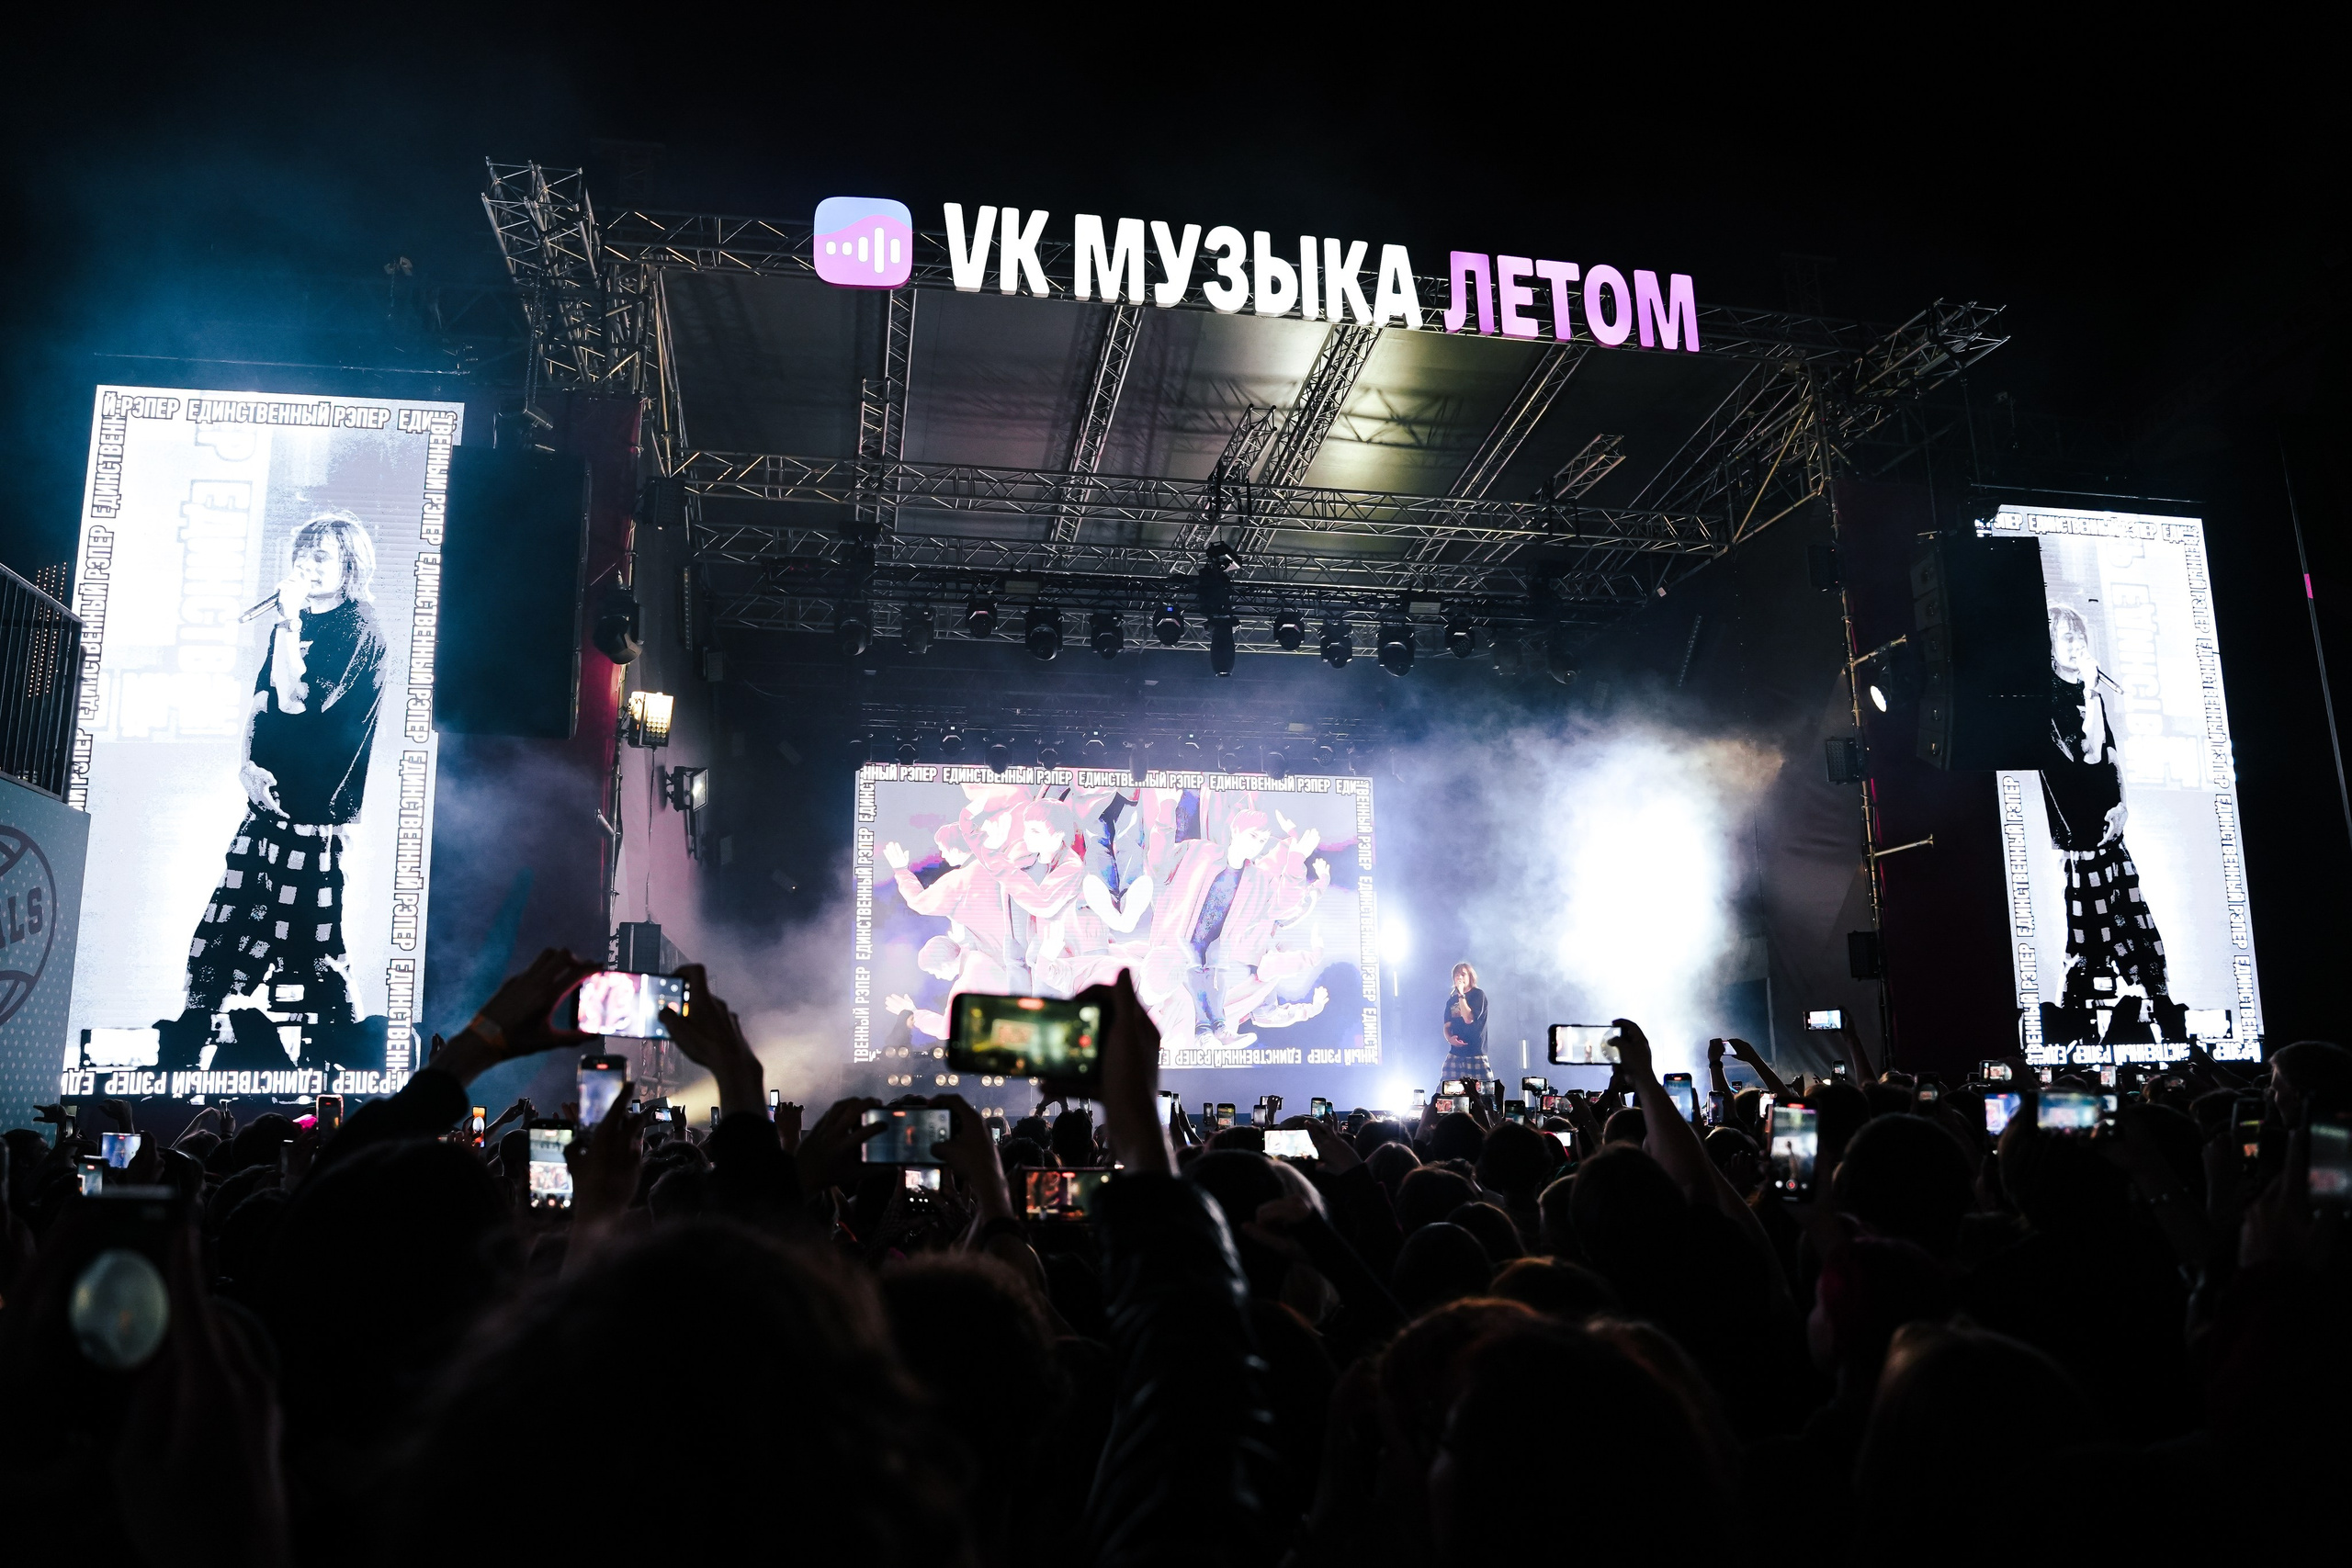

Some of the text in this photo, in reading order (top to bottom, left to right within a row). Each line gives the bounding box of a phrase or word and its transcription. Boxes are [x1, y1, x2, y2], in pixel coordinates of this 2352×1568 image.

[944, 203, 1701, 354] VK МУЗЫКА ЛЕТОМ
[119, 396, 180, 420] РЭПЕР
[187, 399, 332, 427] ЕДИНСТВЕННЫЙ
[333, 406, 391, 429] РЭПЕР
[420, 492, 447, 546] РЭПЕР
[84, 525, 115, 581] РЭПЕР
[404, 688, 433, 743] РЭПЕР
[899, 766, 938, 783] РЭПЕР
[943, 765, 1035, 784] ЕДИНСТВЕННЫЙ
[1035, 769, 1073, 785] РЭПЕР
[1078, 769, 1167, 788] ЕДИНСТВЕНЫЙ
[1170, 773, 1204, 790] РЭПЕР
[1209, 773, 1296, 792] ЕДИНСТВЕННЫЙ
[1296, 777, 1331, 793] РЭПЕР
[2003, 775, 2023, 821] РЭПЕР
[394, 750, 428, 890] ЕДИНСТВЕННЫЙ
[857, 827, 874, 864] РЭПЕР
[1358, 835, 1373, 871] РЭПЕР
[2214, 794, 2245, 903] ЕДИНСТВЕННЫЙ
[2005, 824, 2035, 937] ЕДИНСТВЕННЫЙ
[391, 893, 420, 951] РЭПЕР
[854, 866, 874, 960] ЕДИНСТВЕННЫЙ
[1357, 875, 1378, 964] ЕДИНСТВЕННЫЙ
[2228, 904, 2249, 950] РЭПЕР
[854, 966, 871, 1004] РЭПЕР
[1361, 965, 1377, 1002] РЭПЕР
[2018, 942, 2039, 990] РЭПЕР
[1175, 1048, 1213, 1066] РЭПЕР
[1214, 1046, 1302, 1067] ЕДИНСТВЕННЫЙ
[1306, 1048, 1341, 1064] РЭПЕР
[2073, 1044, 2112, 1065] РЭПЕР
[105, 1071, 167, 1095] РЭПЕР
[172, 1067, 322, 1099] ЕДИНСТВЕННЫЙ
[332, 1071, 390, 1094] РЭПЕР
